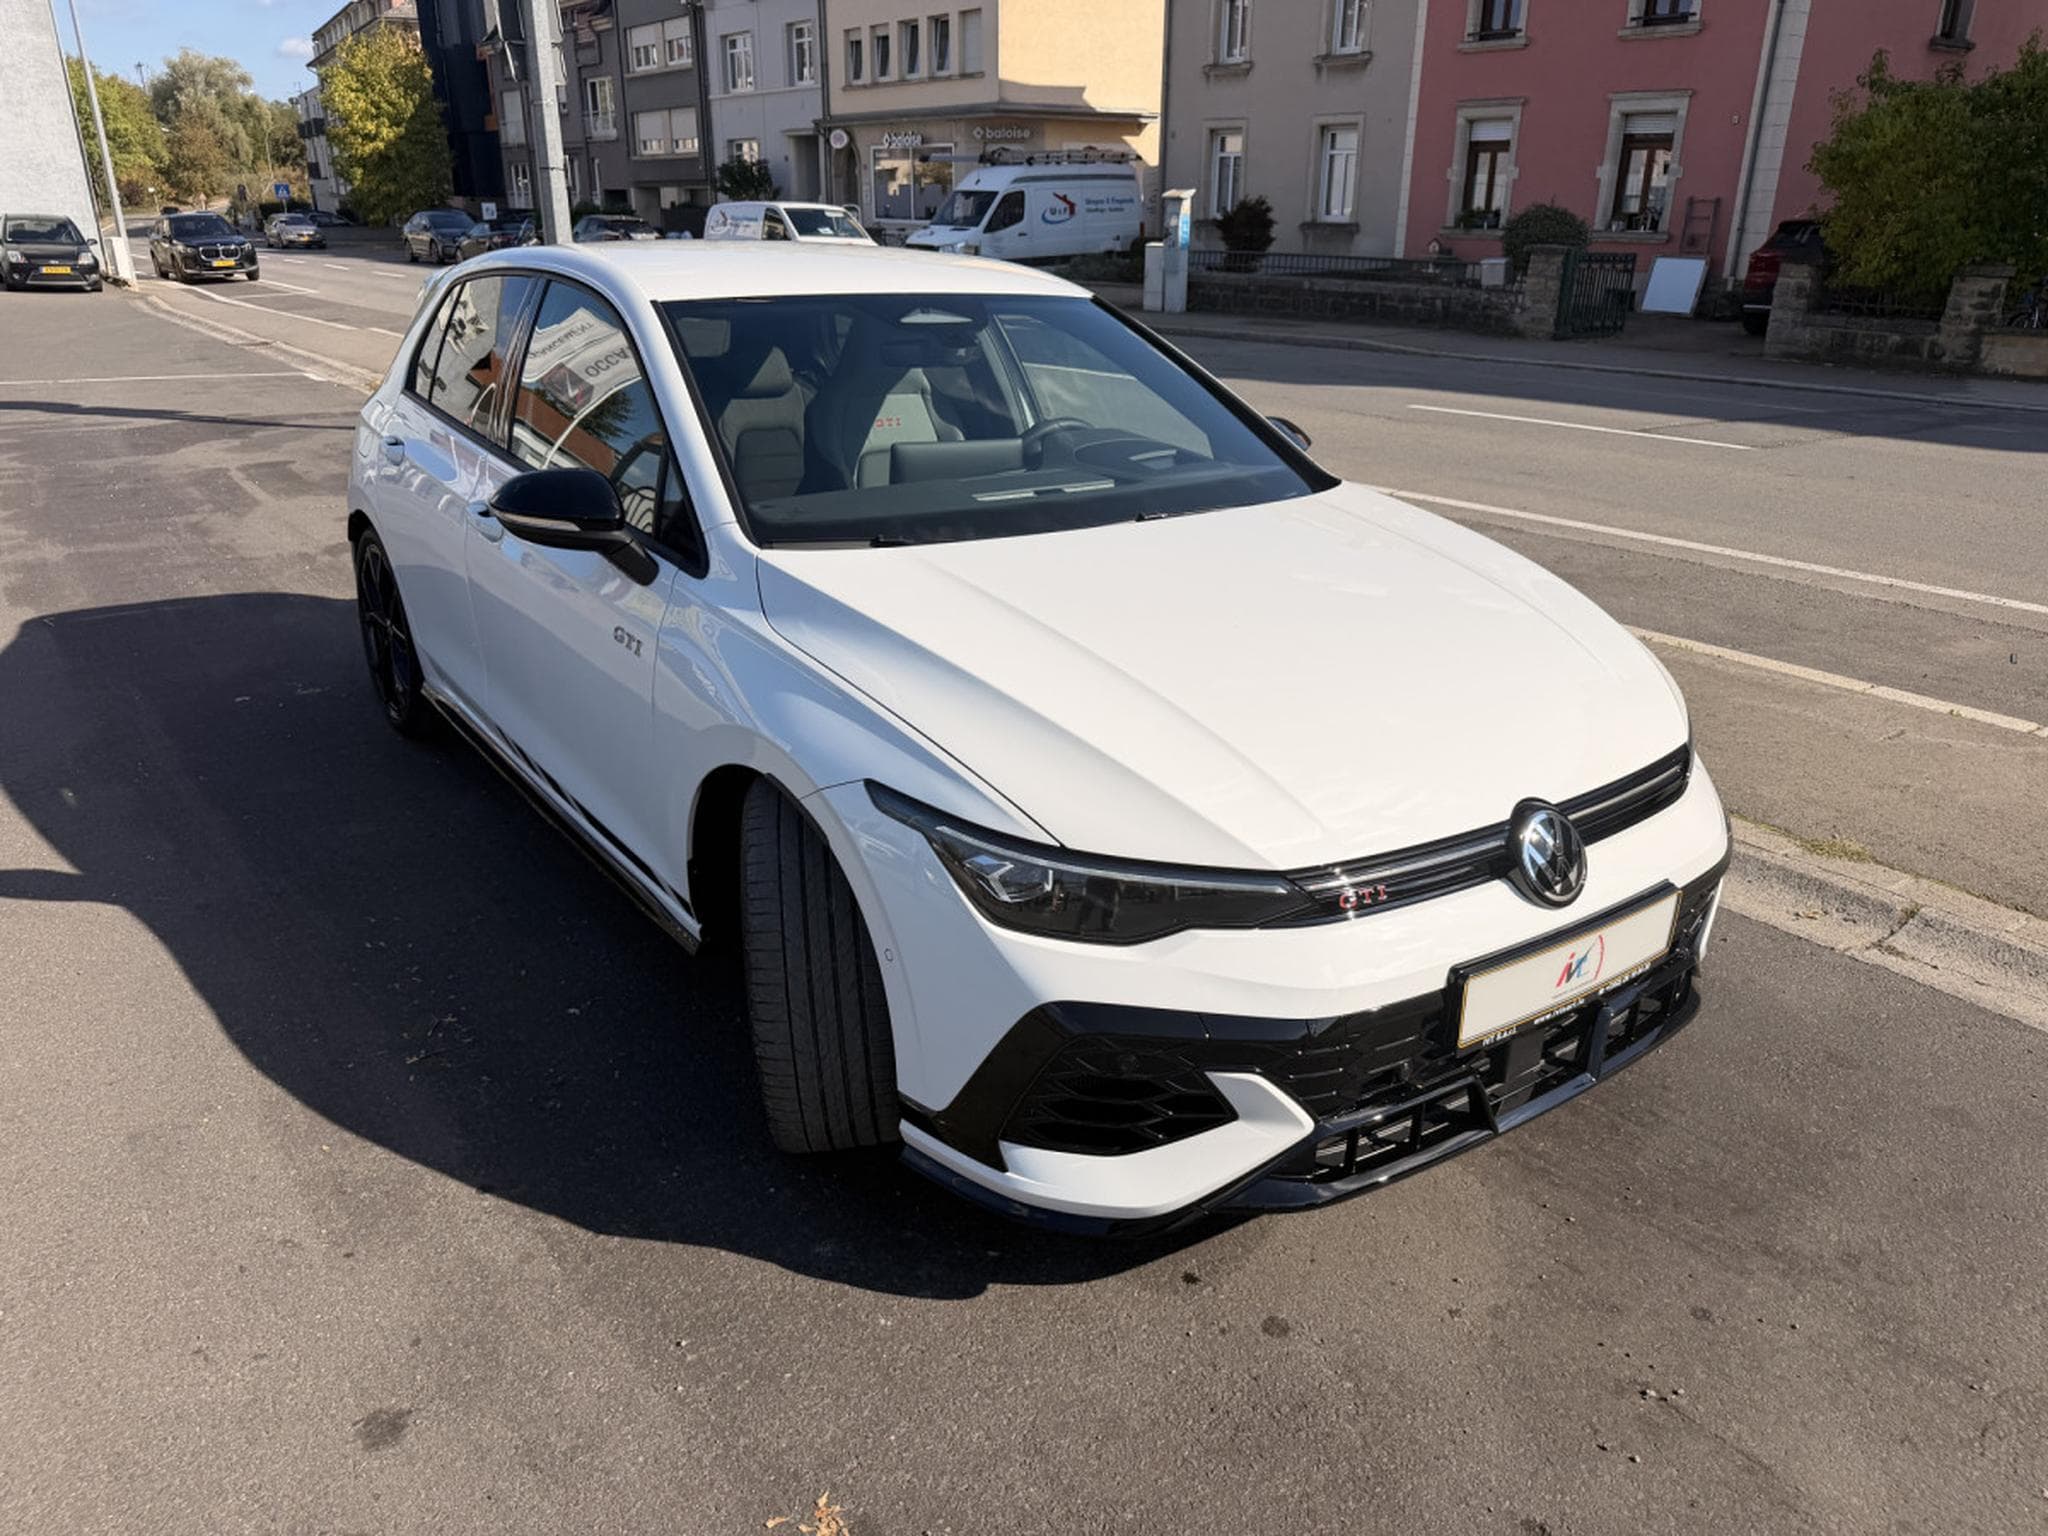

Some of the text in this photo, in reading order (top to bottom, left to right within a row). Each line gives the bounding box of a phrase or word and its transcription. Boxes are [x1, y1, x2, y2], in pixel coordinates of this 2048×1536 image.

[890, 130, 922, 147] baloise
[985, 126, 1031, 139] baloise
[875, 416, 902, 428] GTI
[614, 625, 642, 657] GTI
[1339, 885, 1387, 909] GTI
